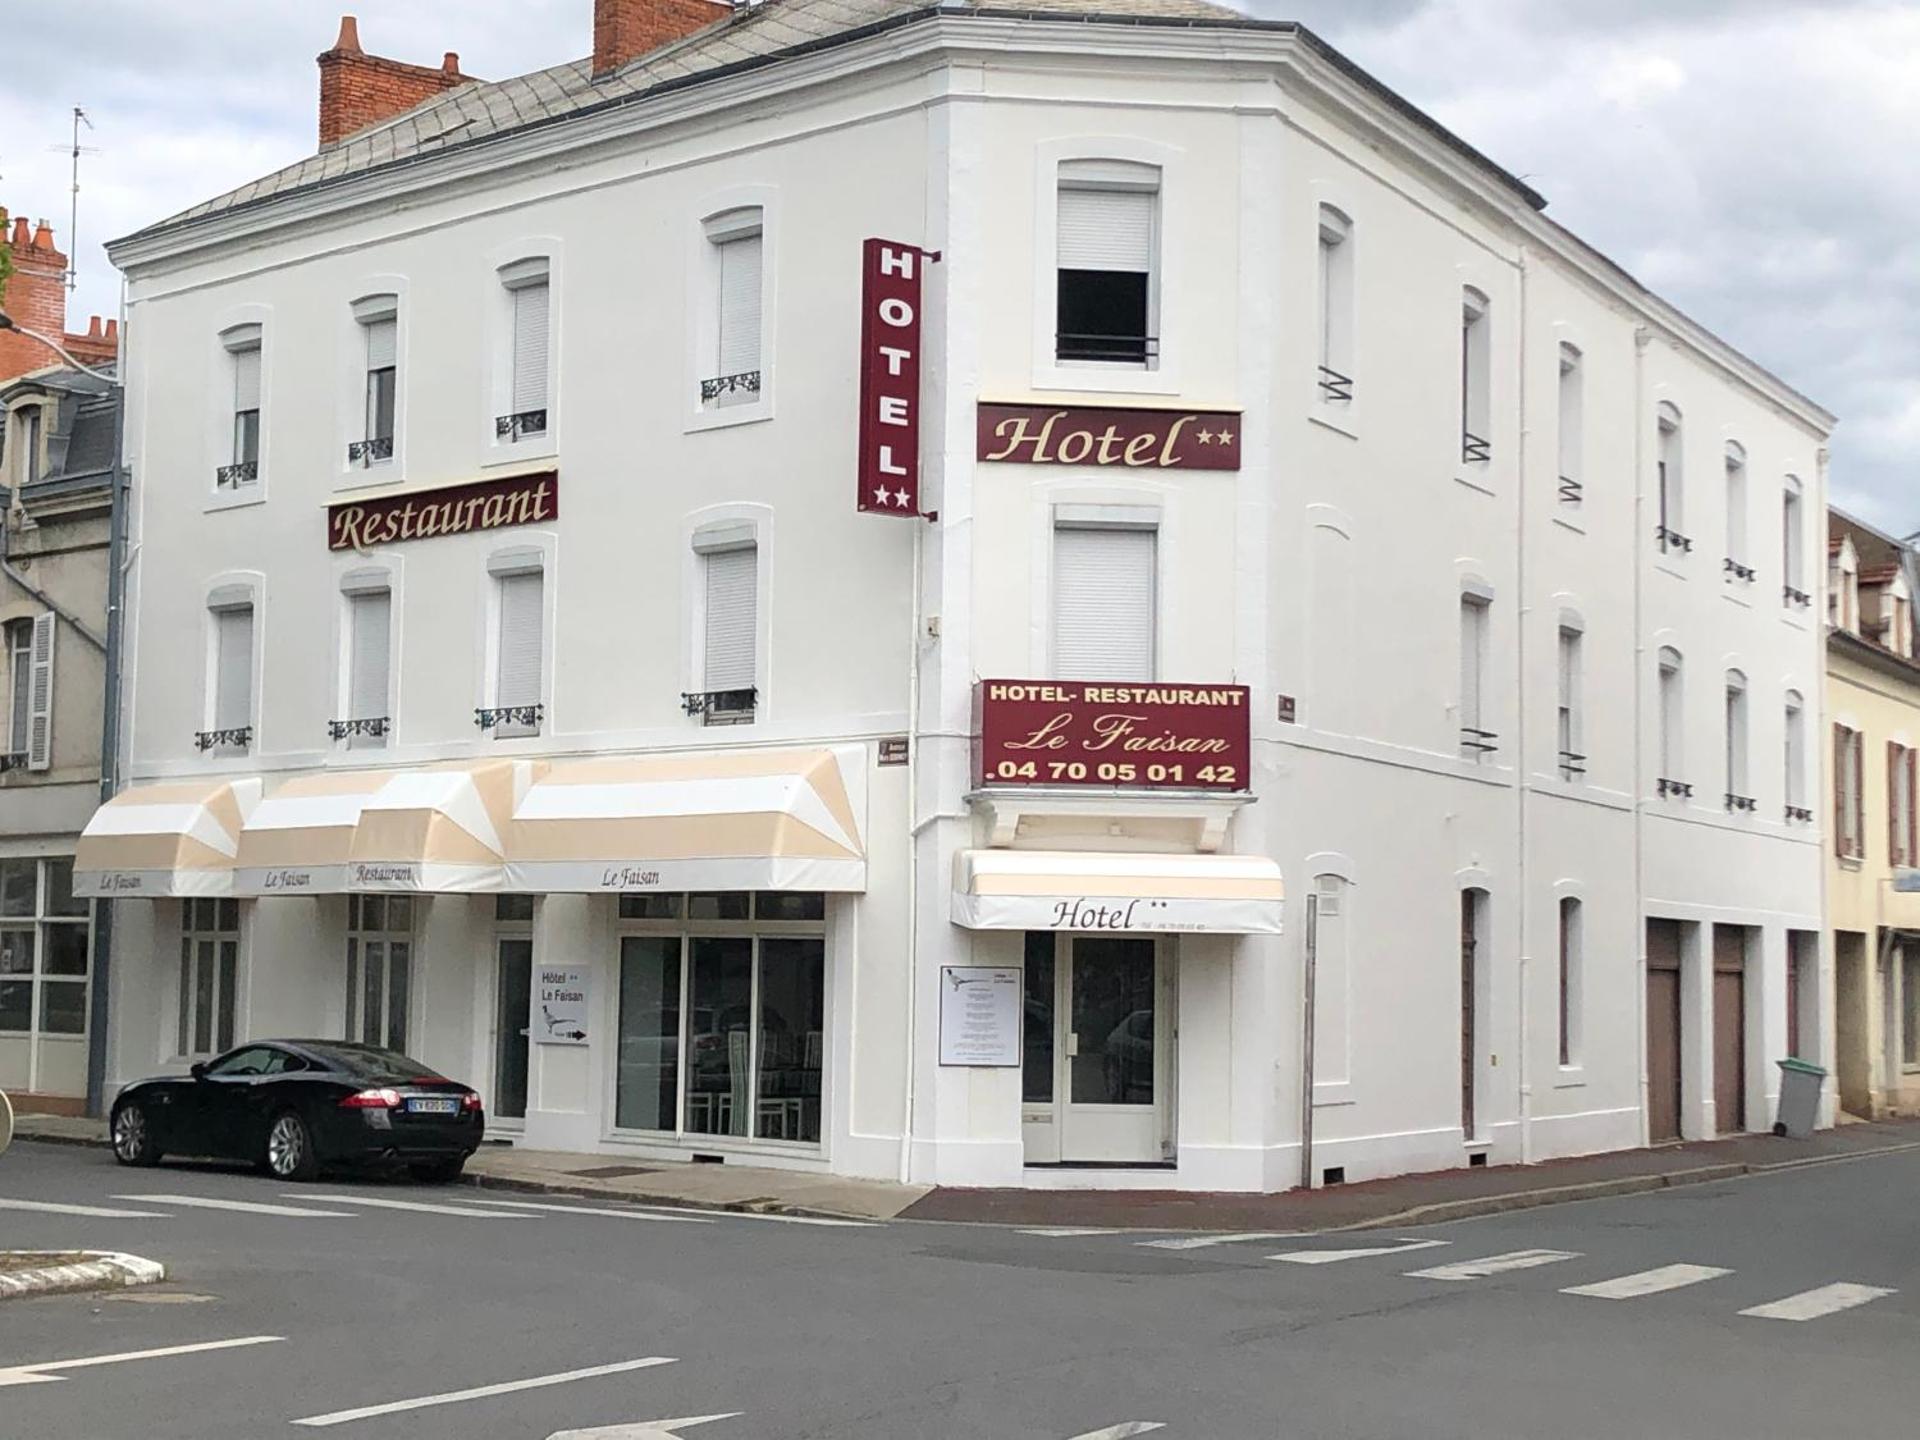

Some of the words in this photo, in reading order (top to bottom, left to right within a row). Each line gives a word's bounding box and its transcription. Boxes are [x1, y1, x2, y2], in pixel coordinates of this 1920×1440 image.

[879, 247, 914, 475] HOTEL
[986, 411, 1197, 467] Hotel
[332, 481, 551, 557] Restaurant
[1085, 687, 1244, 705] RESTAURANT
[1003, 712, 1073, 750] Le
[1082, 713, 1230, 753] Faisan
[1048, 762, 1088, 779] 70
[1097, 763, 1137, 780] 05
[1147, 764, 1184, 782] 01
[1196, 765, 1237, 783] 42
[265, 872, 277, 888] Le
[278, 870, 310, 889] Faisan
[356, 865, 412, 884] Restaurant
[601, 867, 618, 886] Le
[620, 867, 660, 888] Faisan
[1050, 897, 1141, 929] Hotel
[542, 989, 553, 1001] Le
[555, 989, 583, 1002] Faisan
